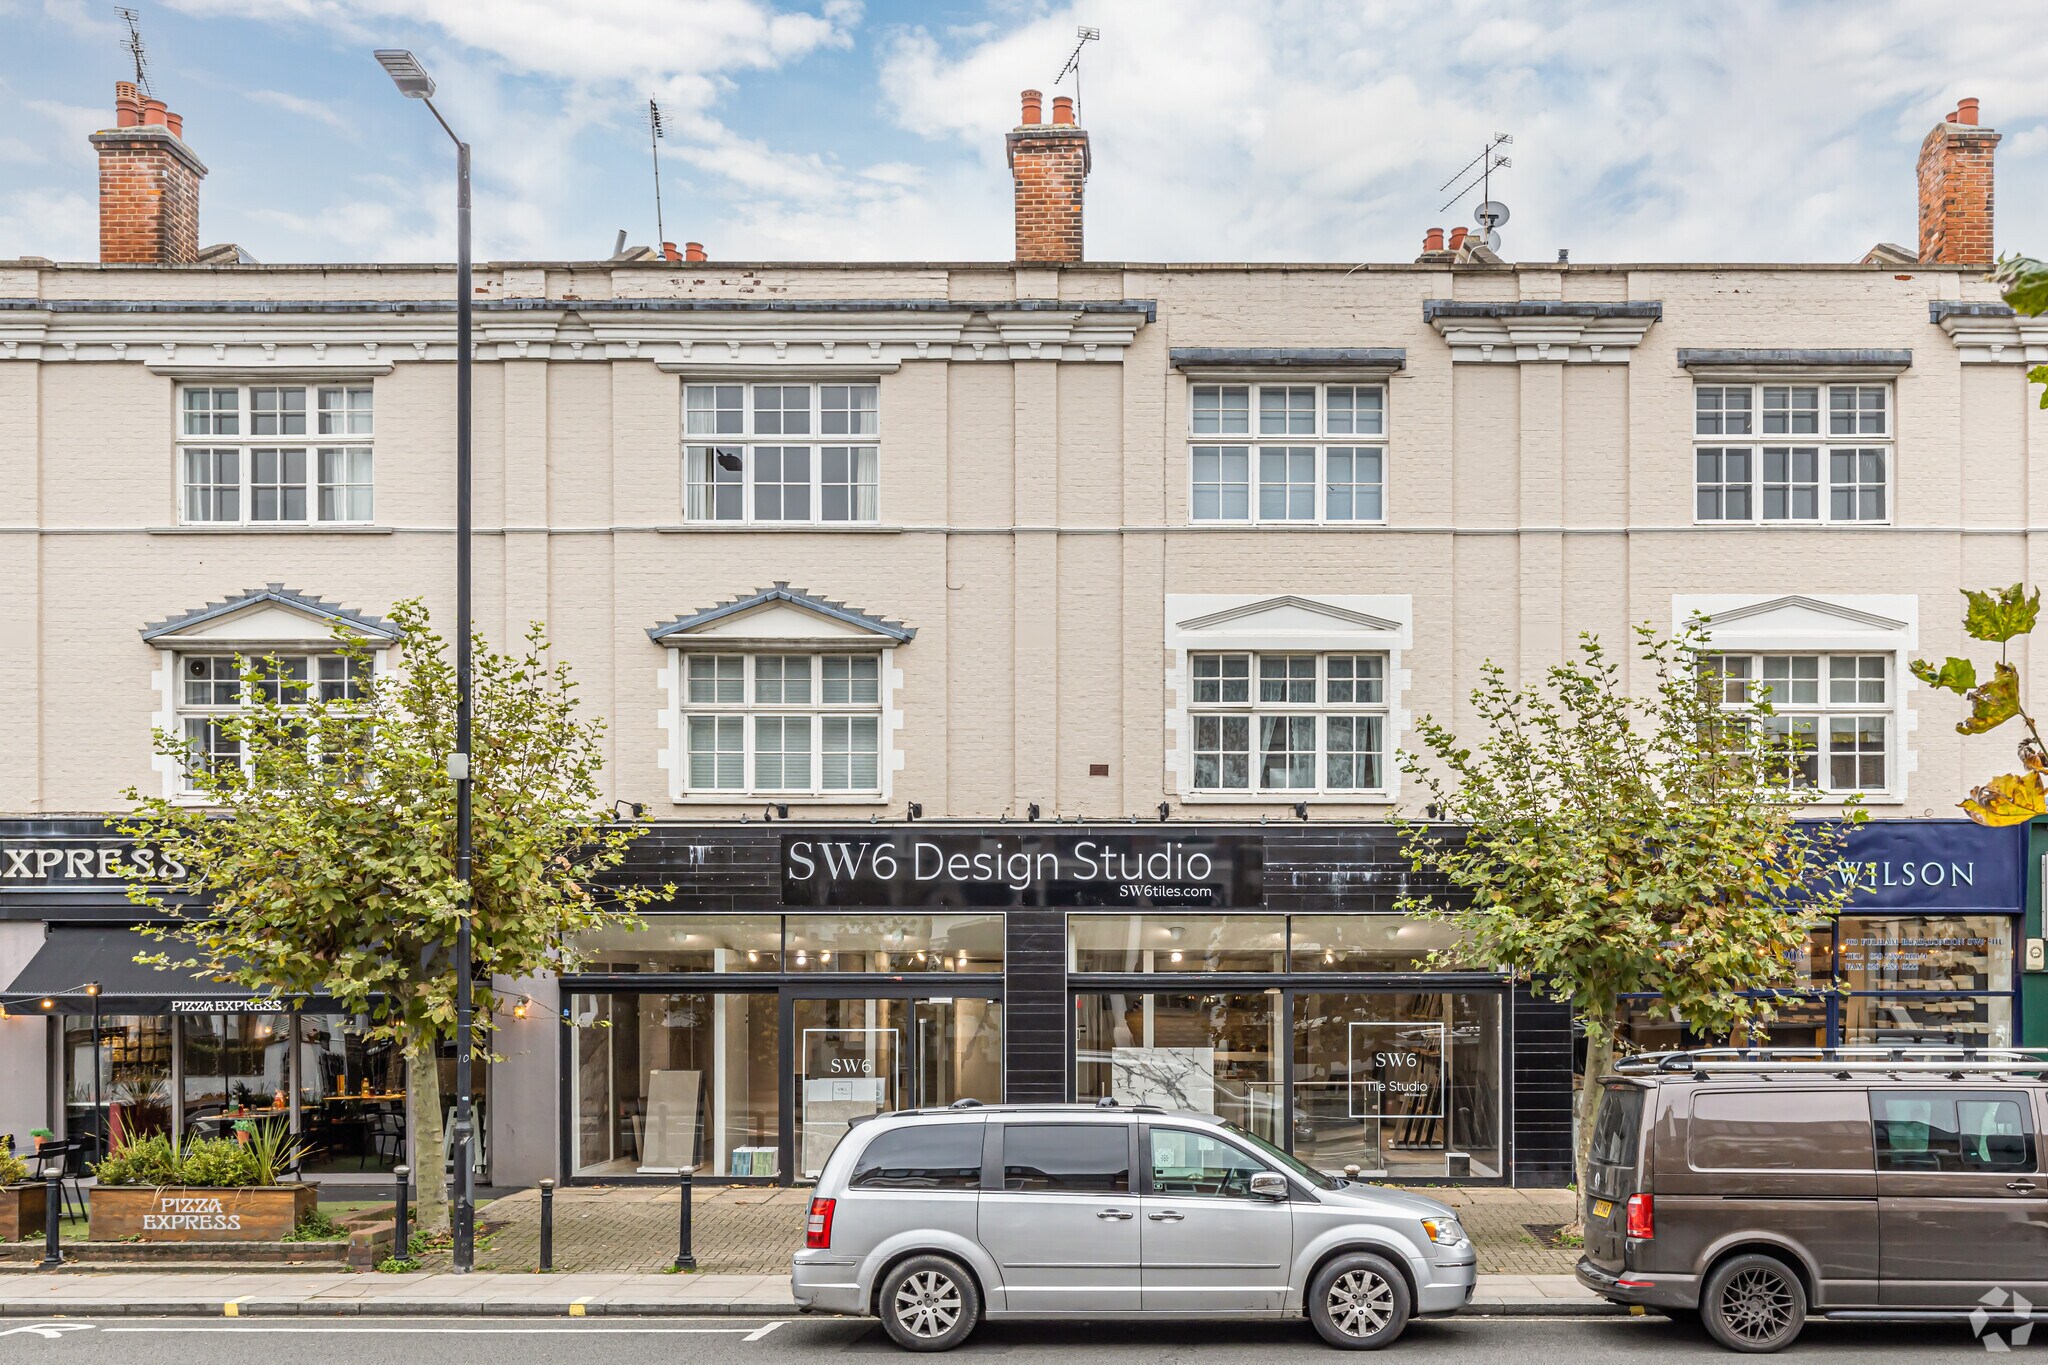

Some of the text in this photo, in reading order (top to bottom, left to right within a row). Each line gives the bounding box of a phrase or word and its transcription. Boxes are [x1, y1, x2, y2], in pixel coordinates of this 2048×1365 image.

[0, 848, 187, 878] XPRESS
[788, 841, 1212, 890] SW6 Design Studio
[1836, 861, 1974, 887] WILSON
[1119, 883, 1212, 898] SW6tiles.com
[831, 1058, 872, 1073] SW6
[1375, 1052, 1417, 1067] SW6
[1389, 1080, 1428, 1092] Studio
[161, 1197, 223, 1213] PIZZA
[143, 1214, 241, 1230] EXPRESS
